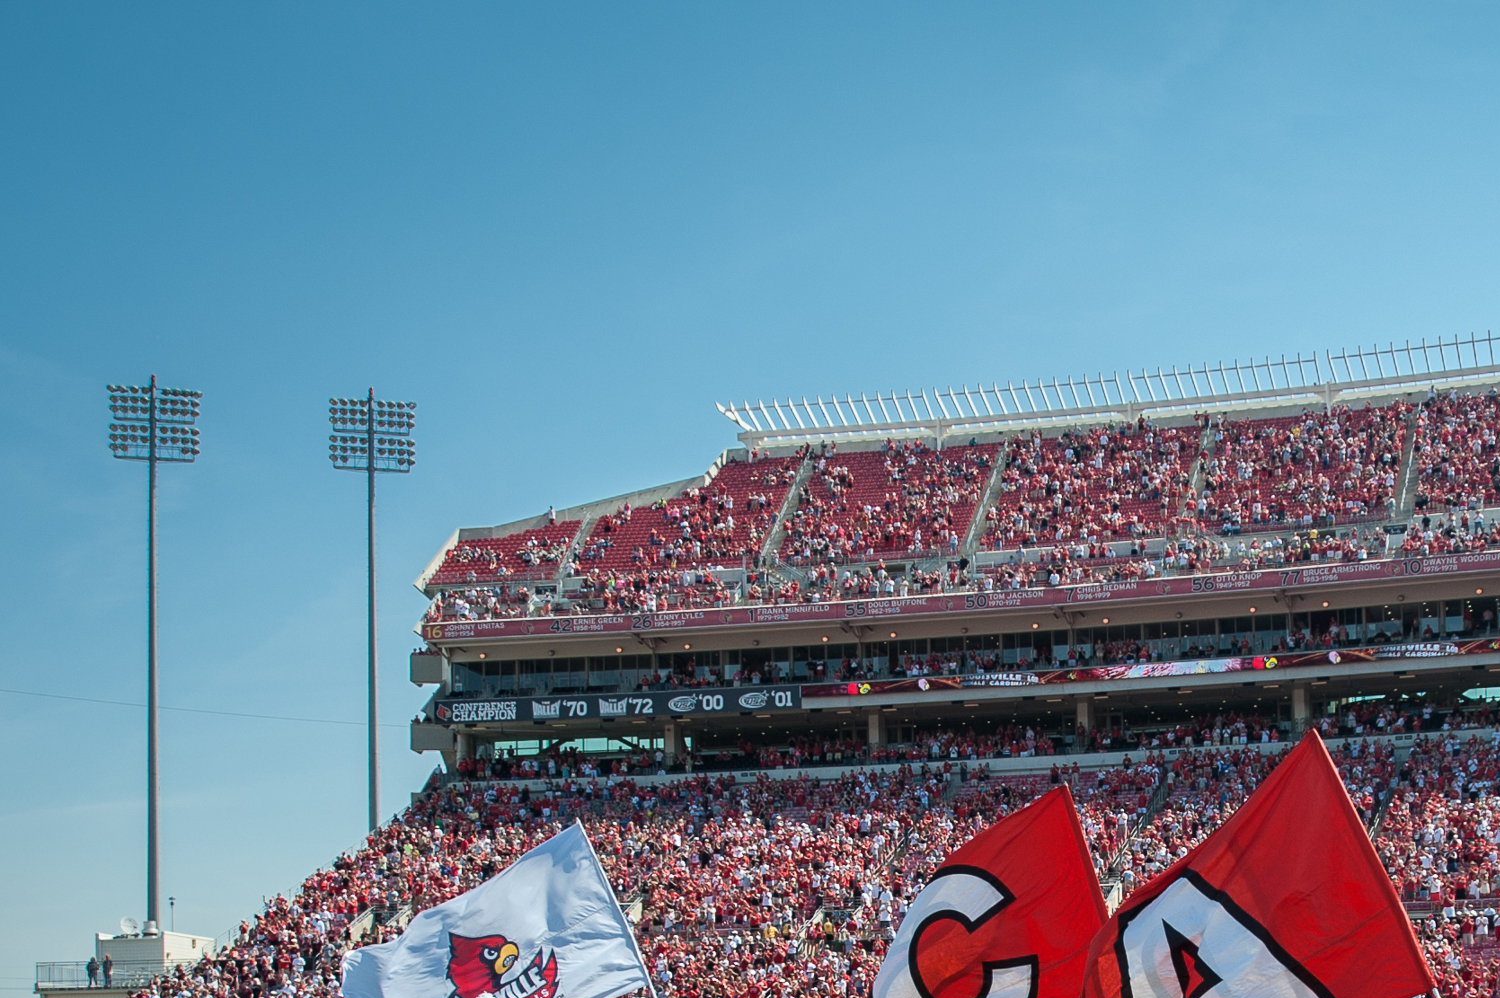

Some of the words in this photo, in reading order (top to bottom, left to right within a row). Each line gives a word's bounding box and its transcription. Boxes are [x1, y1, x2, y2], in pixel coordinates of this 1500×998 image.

[1280, 570, 1301, 585] 77
[1303, 568, 1330, 576] BRUCE
[1331, 562, 1380, 574] ARMSTRONG
[1402, 560, 1421, 575] 10
[1423, 557, 1458, 566] DWAYNE
[1191, 576, 1214, 591] 56
[1216, 574, 1237, 582] OTTO
[1239, 572, 1262, 581] KNOP
[965, 595, 987, 609] 50
[988, 592, 1005, 600] TOM
[1007, 590, 1044, 599] JACKSON
[1065, 588, 1075, 602] 7
[1077, 585, 1101, 594] CHRIS
[1103, 582, 1137, 592] REDMAN
[748, 609, 754, 622] 1
[757, 607, 783, 615] FRANK
[785, 604, 829, 614] MINNIFIELD
[845, 603, 866, 617] 55
[868, 601, 889, 609] DOUG
[891, 598, 926, 607] BUFFONE
[550, 618, 572, 633] 42
[573, 617, 596, 625] ERNIE
[598, 616, 624, 624] GREEN
[631, 615, 652, 630] 26
[681, 612, 704, 620] LYLES
[426, 625, 442, 639] 16
[445, 623, 475, 632] JOHNNY
[477, 622, 505, 630] UNITAS
[452, 701, 517, 713] CONFERENCE
[629, 697, 653, 714] '72
[699, 694, 724, 710] '00
[770, 690, 793, 707] '01
[452, 710, 517, 722] CHAMPION
[562, 700, 587, 717] '70
